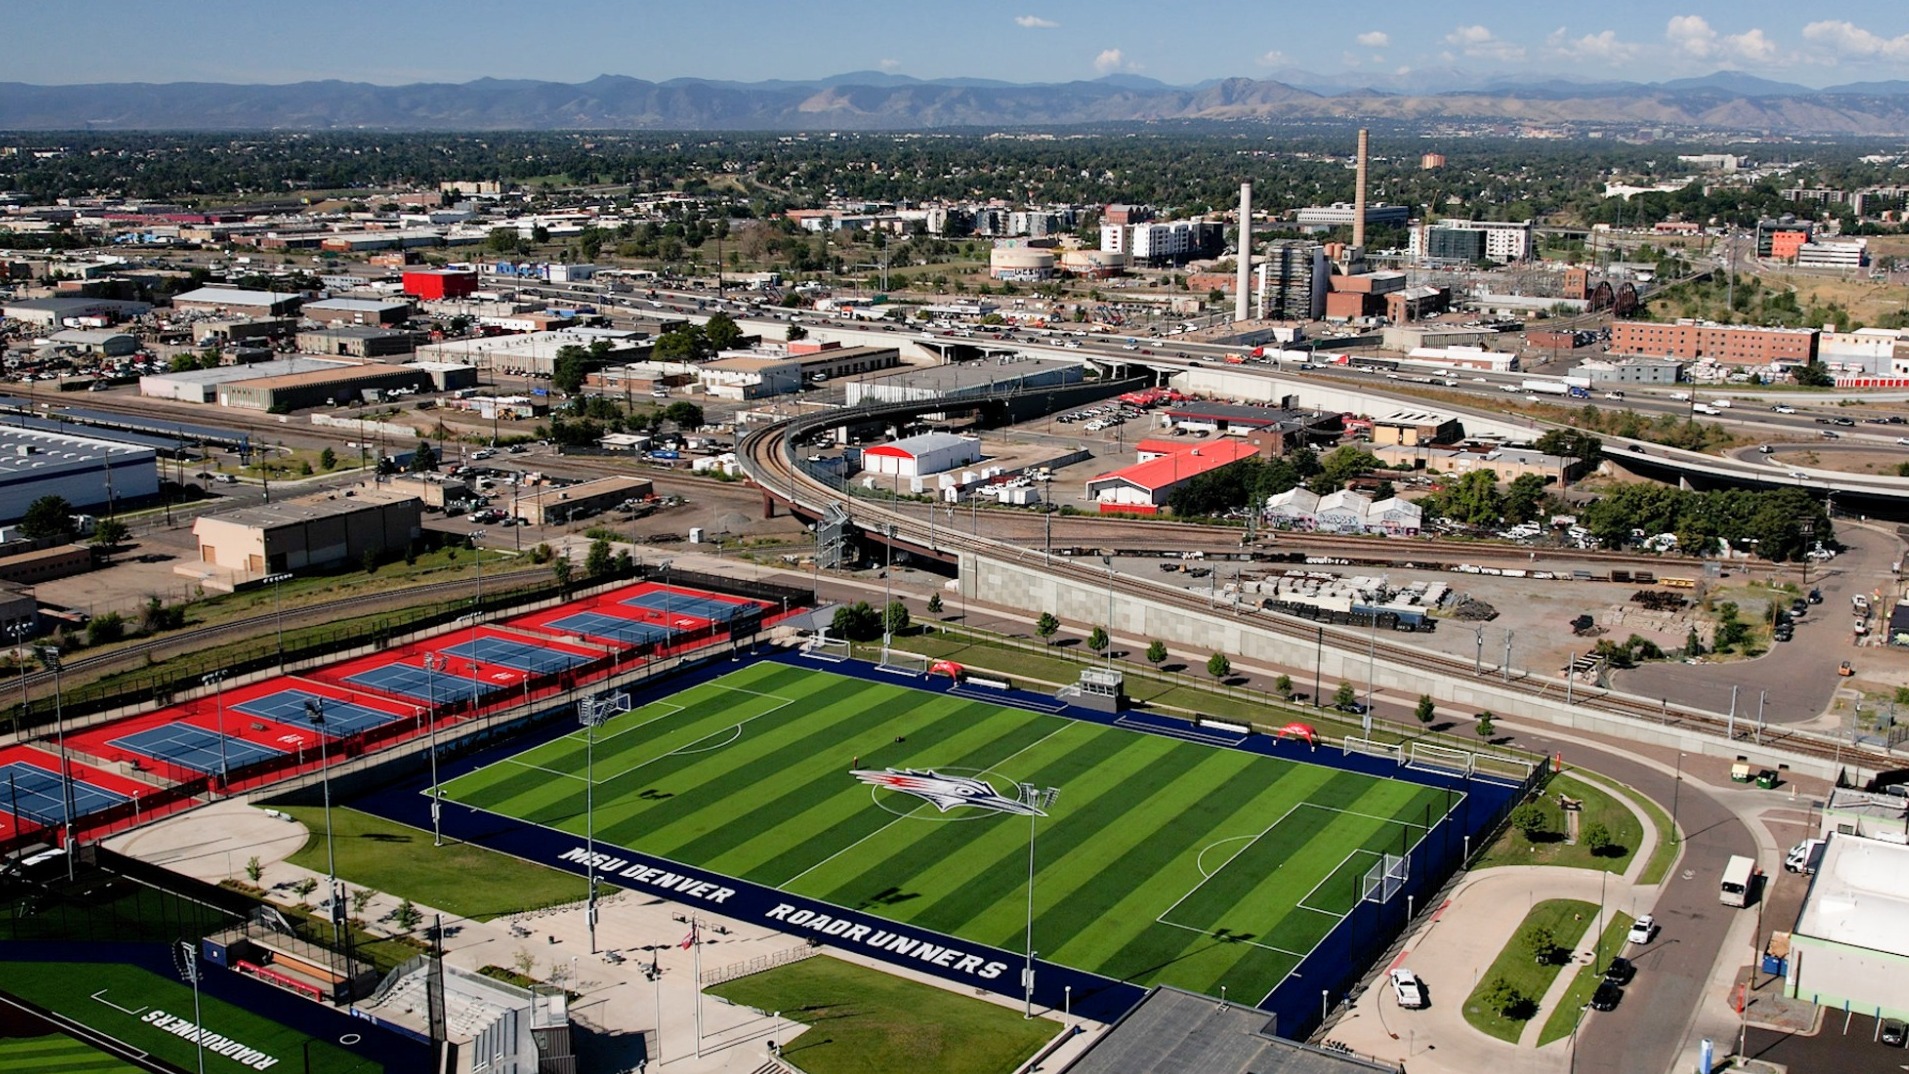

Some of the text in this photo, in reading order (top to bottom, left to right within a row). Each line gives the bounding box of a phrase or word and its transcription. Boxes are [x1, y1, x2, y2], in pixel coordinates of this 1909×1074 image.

[557, 846, 1008, 980] MSU DENVER ROADRUNNERS
[141, 1010, 279, 1071] ROADRUNNERS
